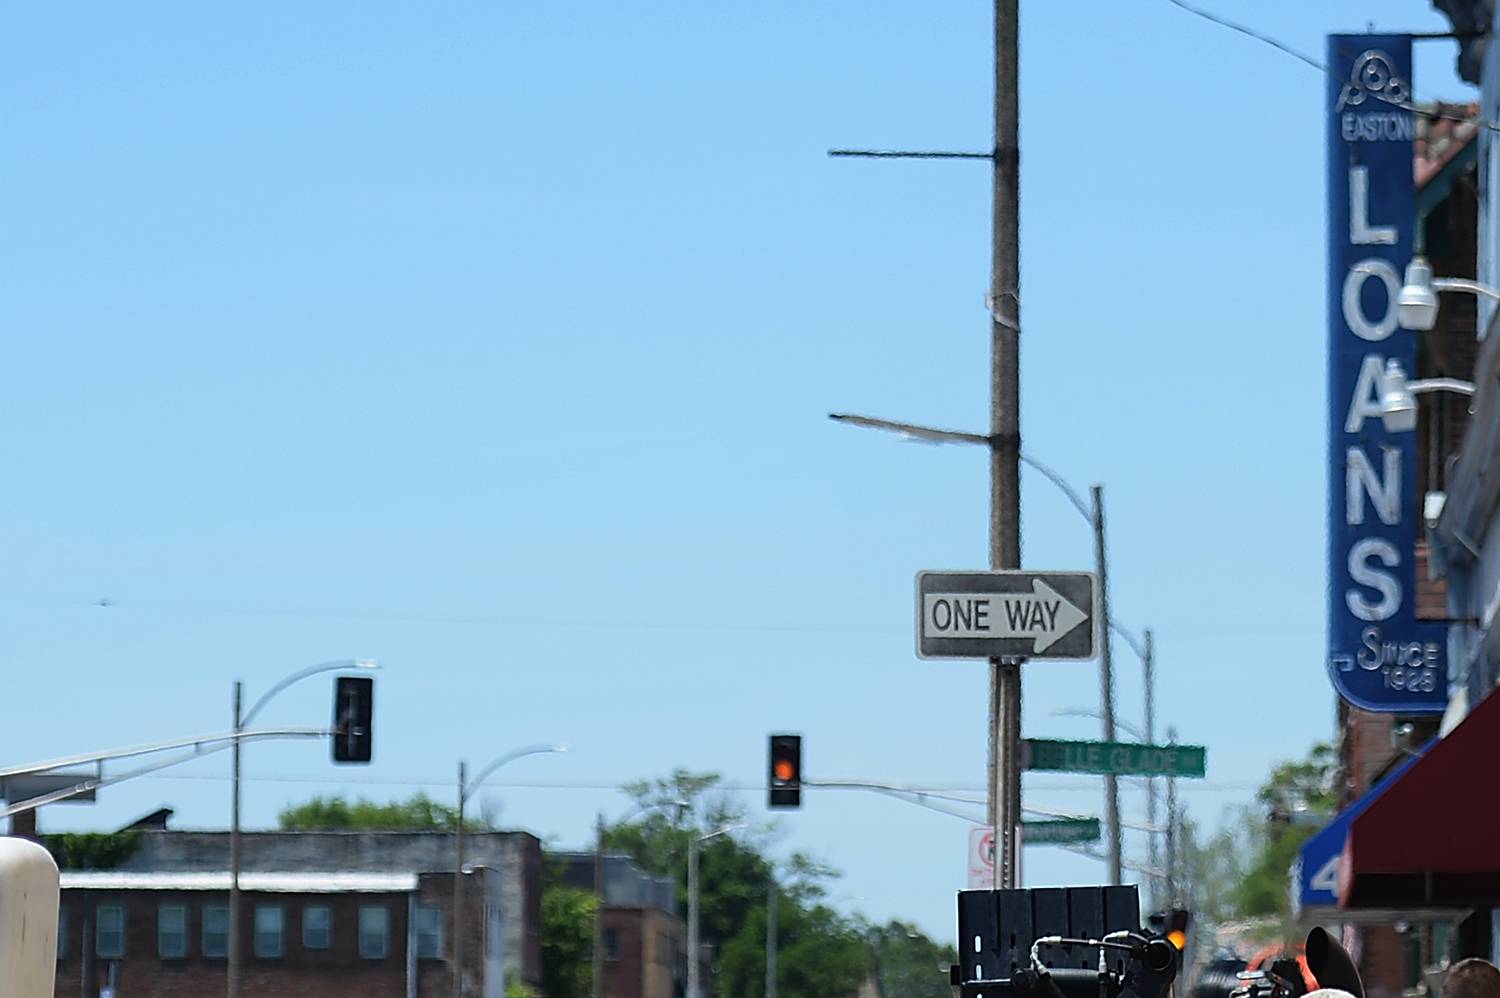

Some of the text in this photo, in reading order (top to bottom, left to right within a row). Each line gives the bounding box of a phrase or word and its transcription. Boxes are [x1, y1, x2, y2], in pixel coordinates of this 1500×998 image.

[1341, 111, 1412, 142] EASTON
[1341, 165, 1403, 623] LOANS
[932, 599, 1061, 632] ONE WAY
